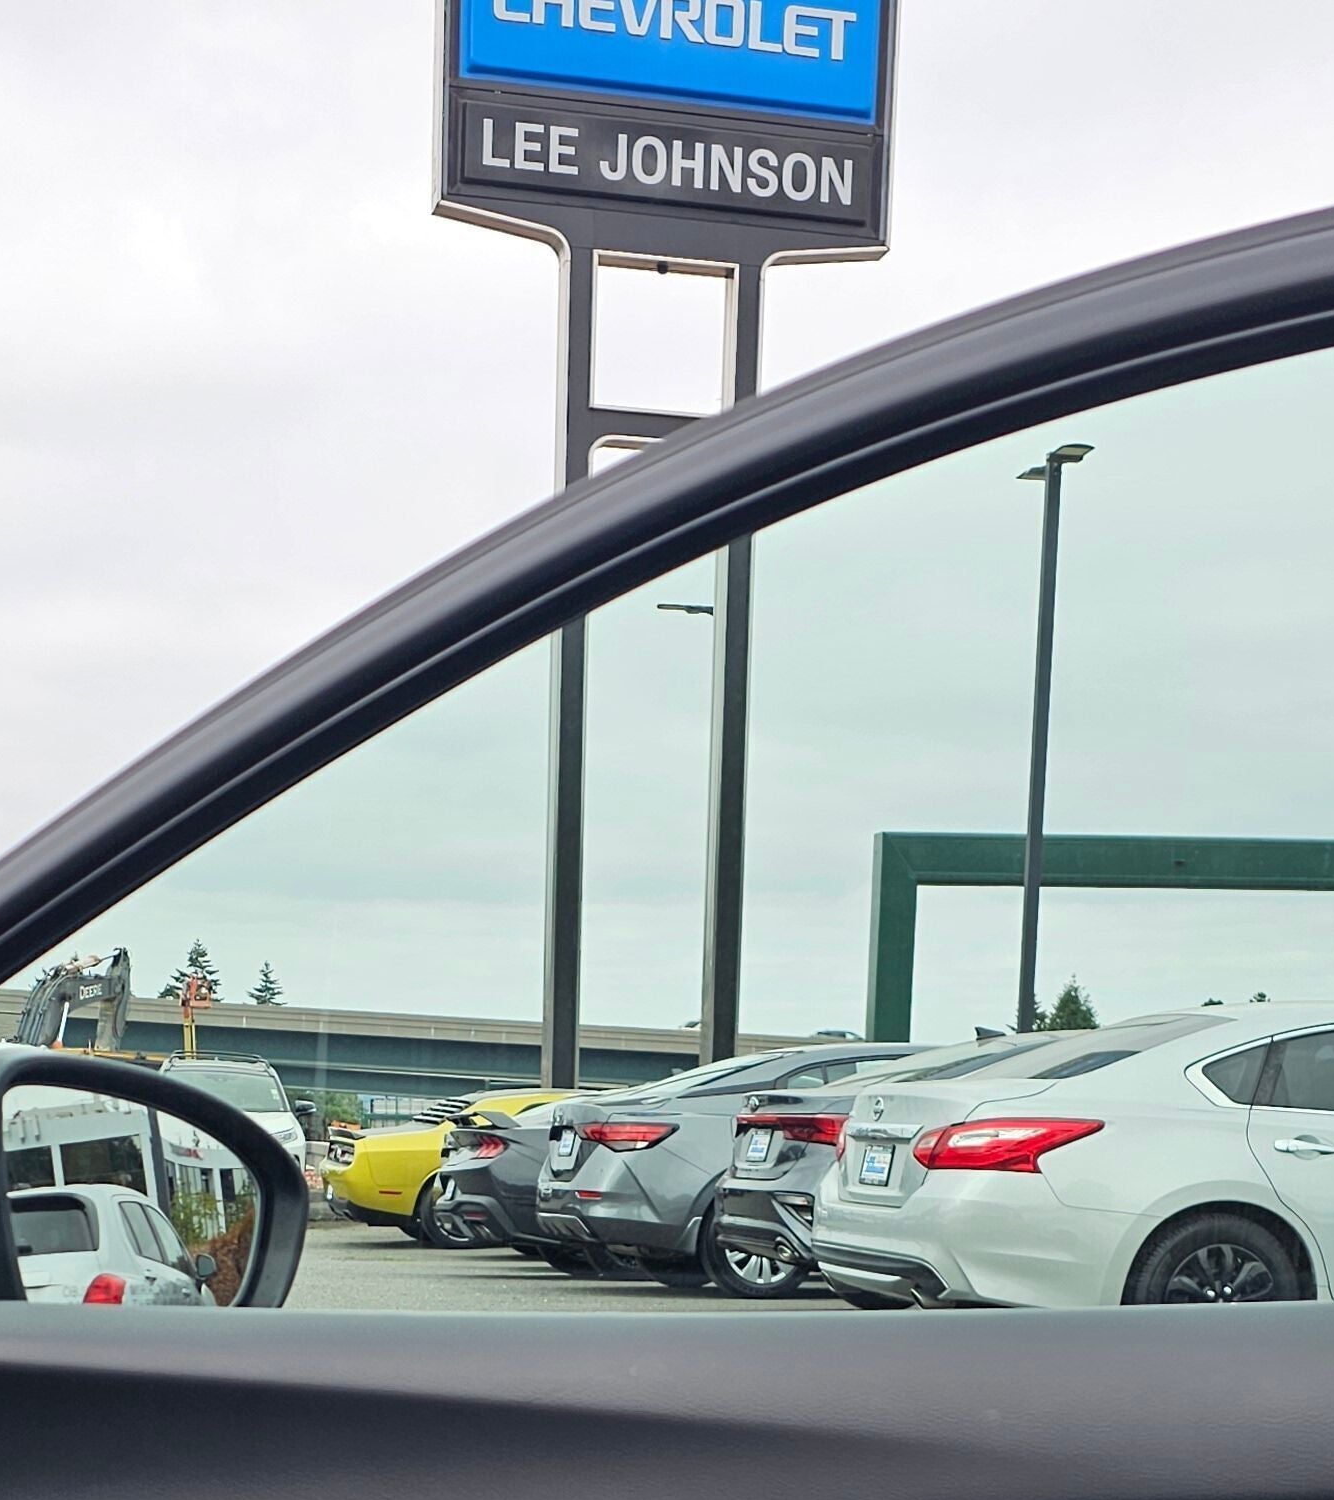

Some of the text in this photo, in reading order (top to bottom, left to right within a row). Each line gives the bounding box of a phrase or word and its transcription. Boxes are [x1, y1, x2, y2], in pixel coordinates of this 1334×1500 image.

[483, 118, 854, 205] LEE JOHNSON
[79, 983, 103, 1000] DEERE
